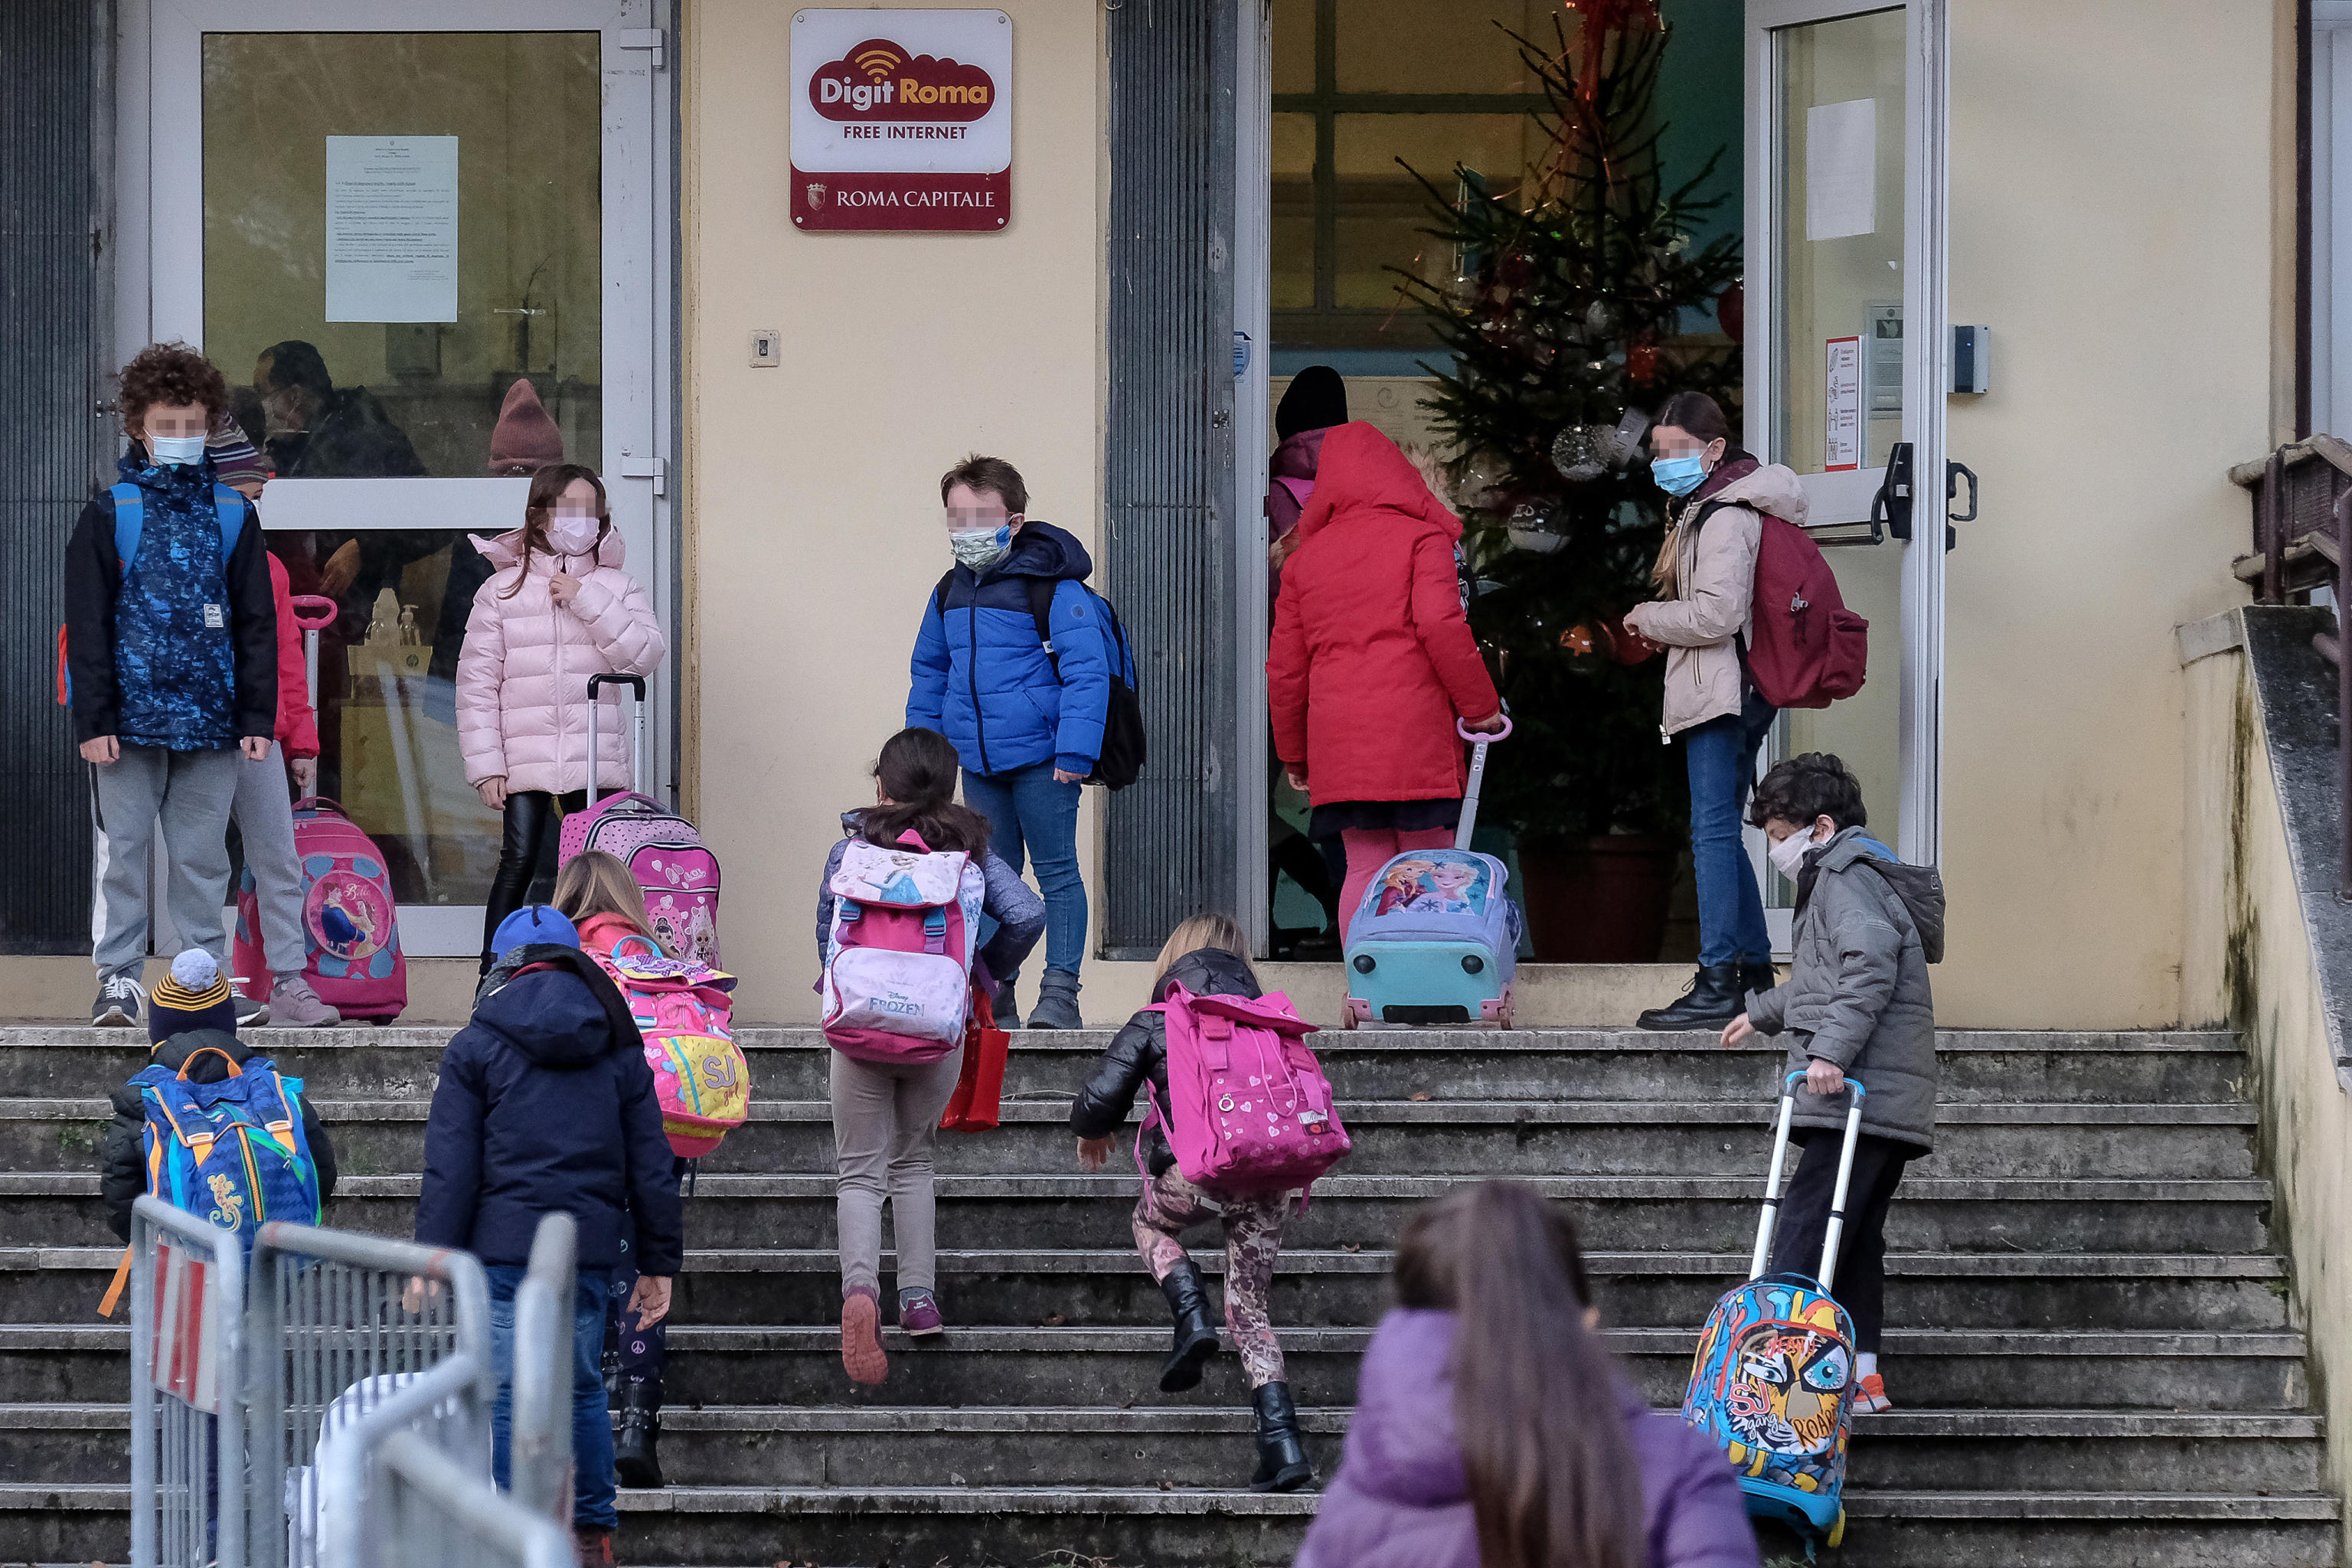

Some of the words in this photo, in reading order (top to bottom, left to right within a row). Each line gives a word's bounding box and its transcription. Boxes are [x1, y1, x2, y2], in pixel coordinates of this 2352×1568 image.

[900, 78, 988, 104] Roma
[844, 126, 880, 139] FREE
[887, 126, 968, 139] INTERNET
[837, 191, 900, 207] ROMA
[903, 191, 995, 207] CAPITALE
[869, 997, 925, 1017] FROZEN
[887, 991, 909, 1002] Disney
[703, 1054, 736, 1089] SJ
[724, 1081, 740, 1107] girl
[1730, 1381, 1771, 1417] SJ
[1748, 1413, 1779, 1441] gang
